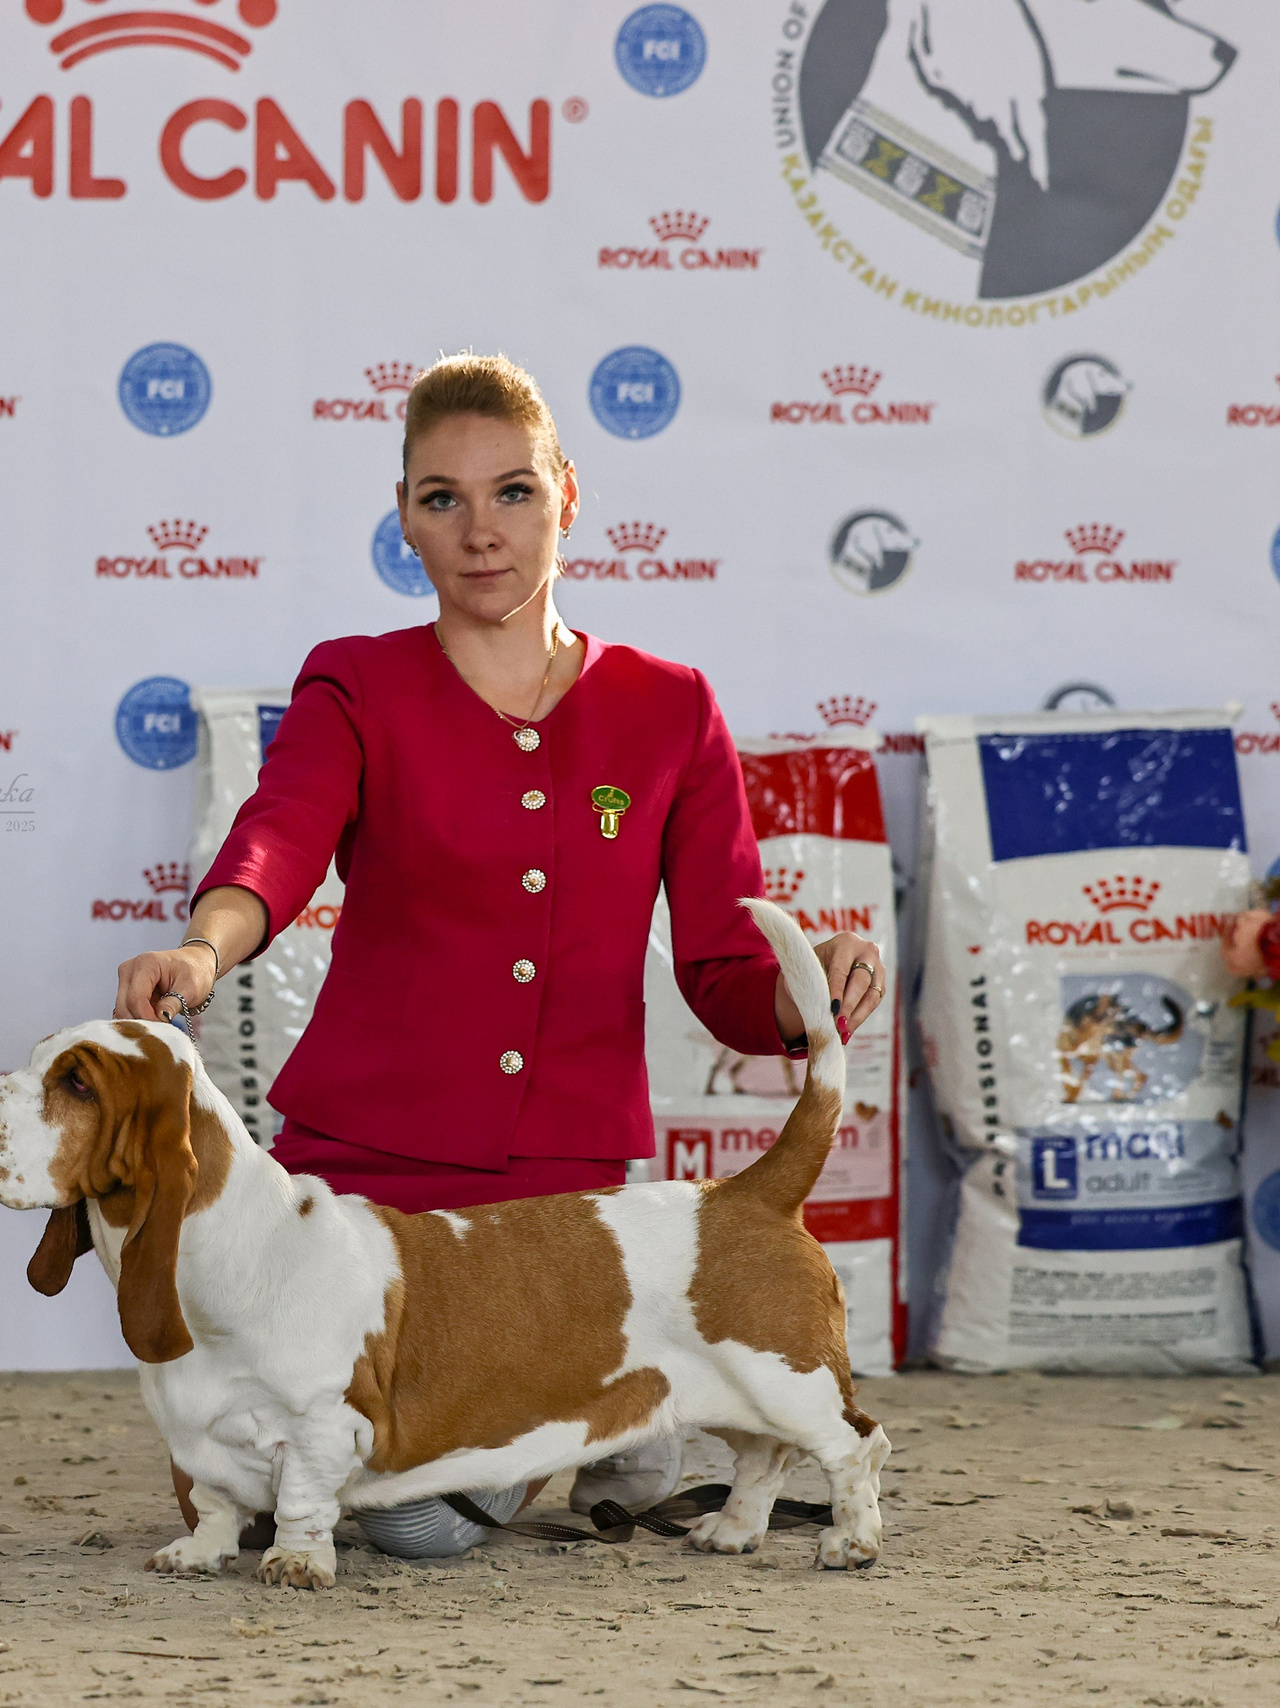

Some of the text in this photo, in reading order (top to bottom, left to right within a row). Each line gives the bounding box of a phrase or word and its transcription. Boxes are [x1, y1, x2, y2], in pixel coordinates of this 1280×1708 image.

[643, 39, 681, 60] FCI
[599, 248, 759, 270] ROYAL CANIN
[147, 378, 185, 399] FCI
[616, 382, 654, 403] FCI
[313, 399, 388, 420] ROYAL
[770, 402, 930, 424] ROYAL CANIN
[96, 557, 259, 579] ROYAL CANIN
[638, 561, 716, 580] CANIN
[1014, 561, 1173, 583] ROYAL CANIN
[144, 712, 181, 734] FCI
[92, 899, 166, 921] ROYAL
[795, 907, 872, 932] ANIN
[1026, 917, 1123, 946] ROYAL
[1043, 1150, 1070, 1189] L
